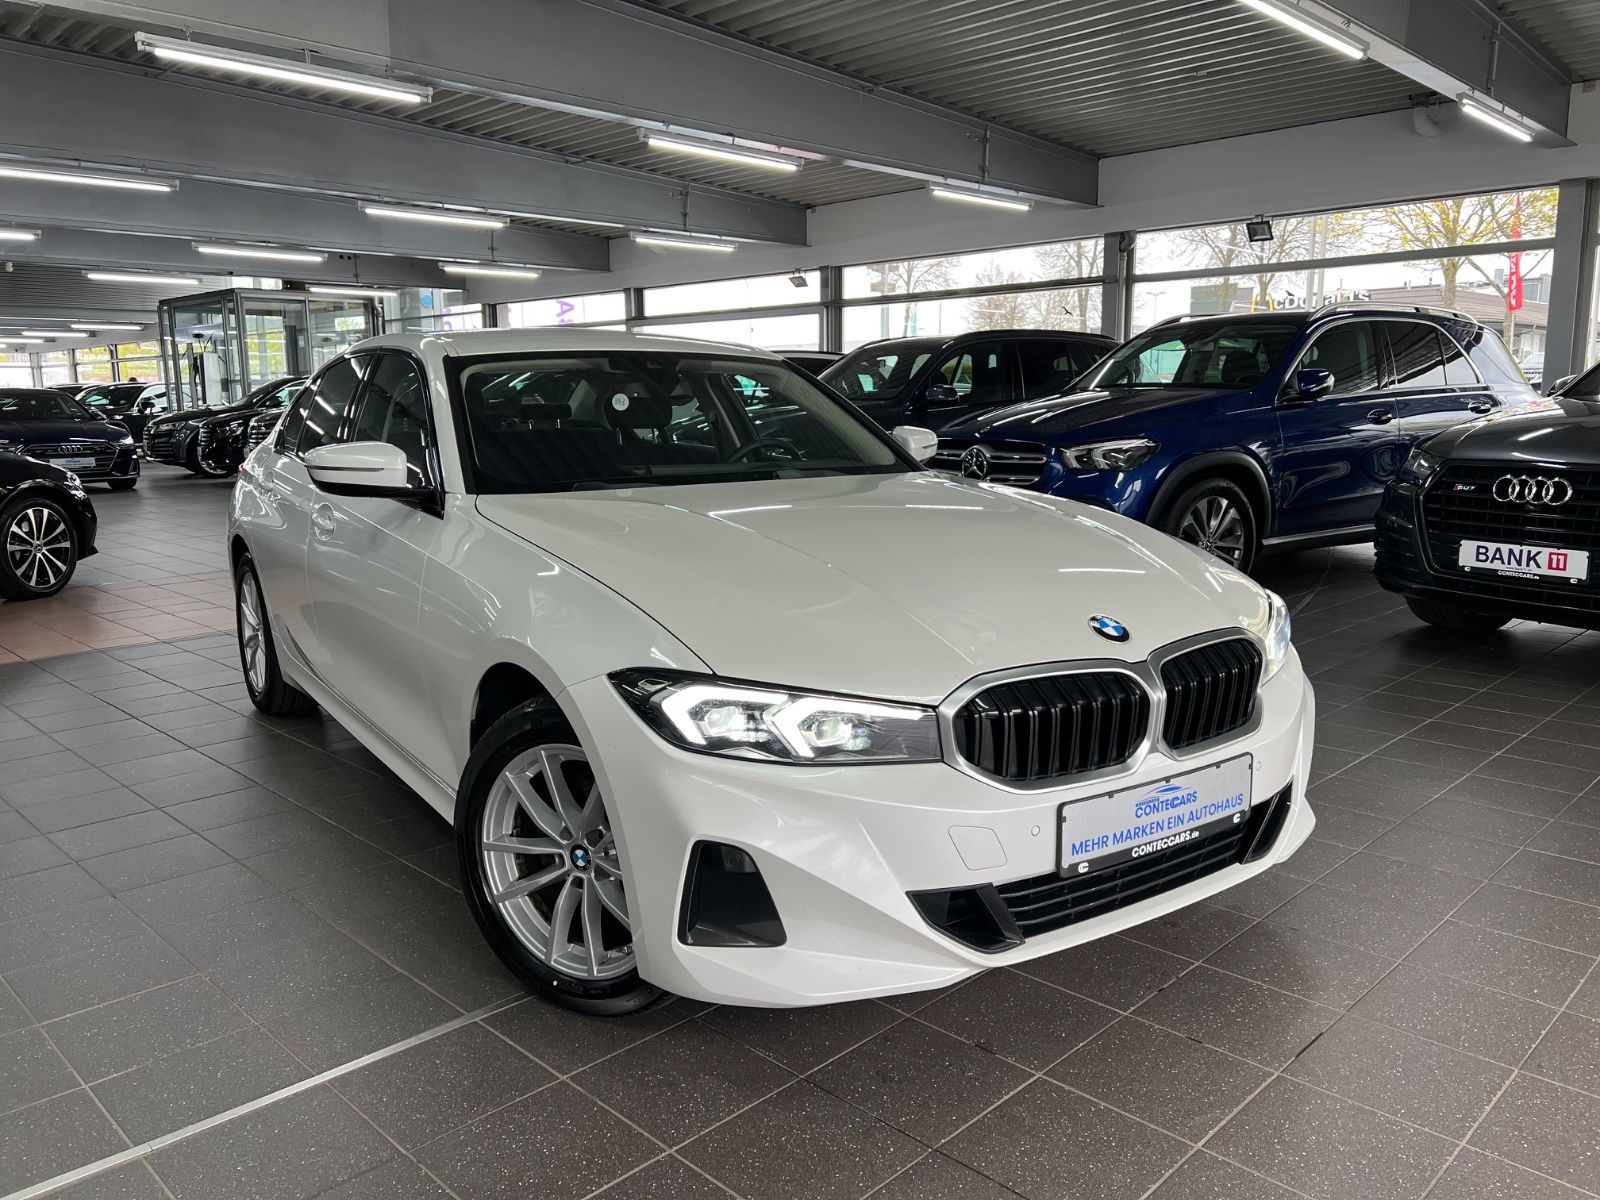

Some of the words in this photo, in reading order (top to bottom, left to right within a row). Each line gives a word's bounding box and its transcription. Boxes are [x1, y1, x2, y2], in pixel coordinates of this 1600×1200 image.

[1475, 545, 1542, 569] BANK
[1071, 834, 1109, 857] MEHR
[1112, 820, 1165, 845] MARKEN
[1167, 814, 1186, 830] EIN
[1187, 792, 1244, 824] AUTOHAUS
[1131, 829, 1200, 858] CONTECCARS.de
